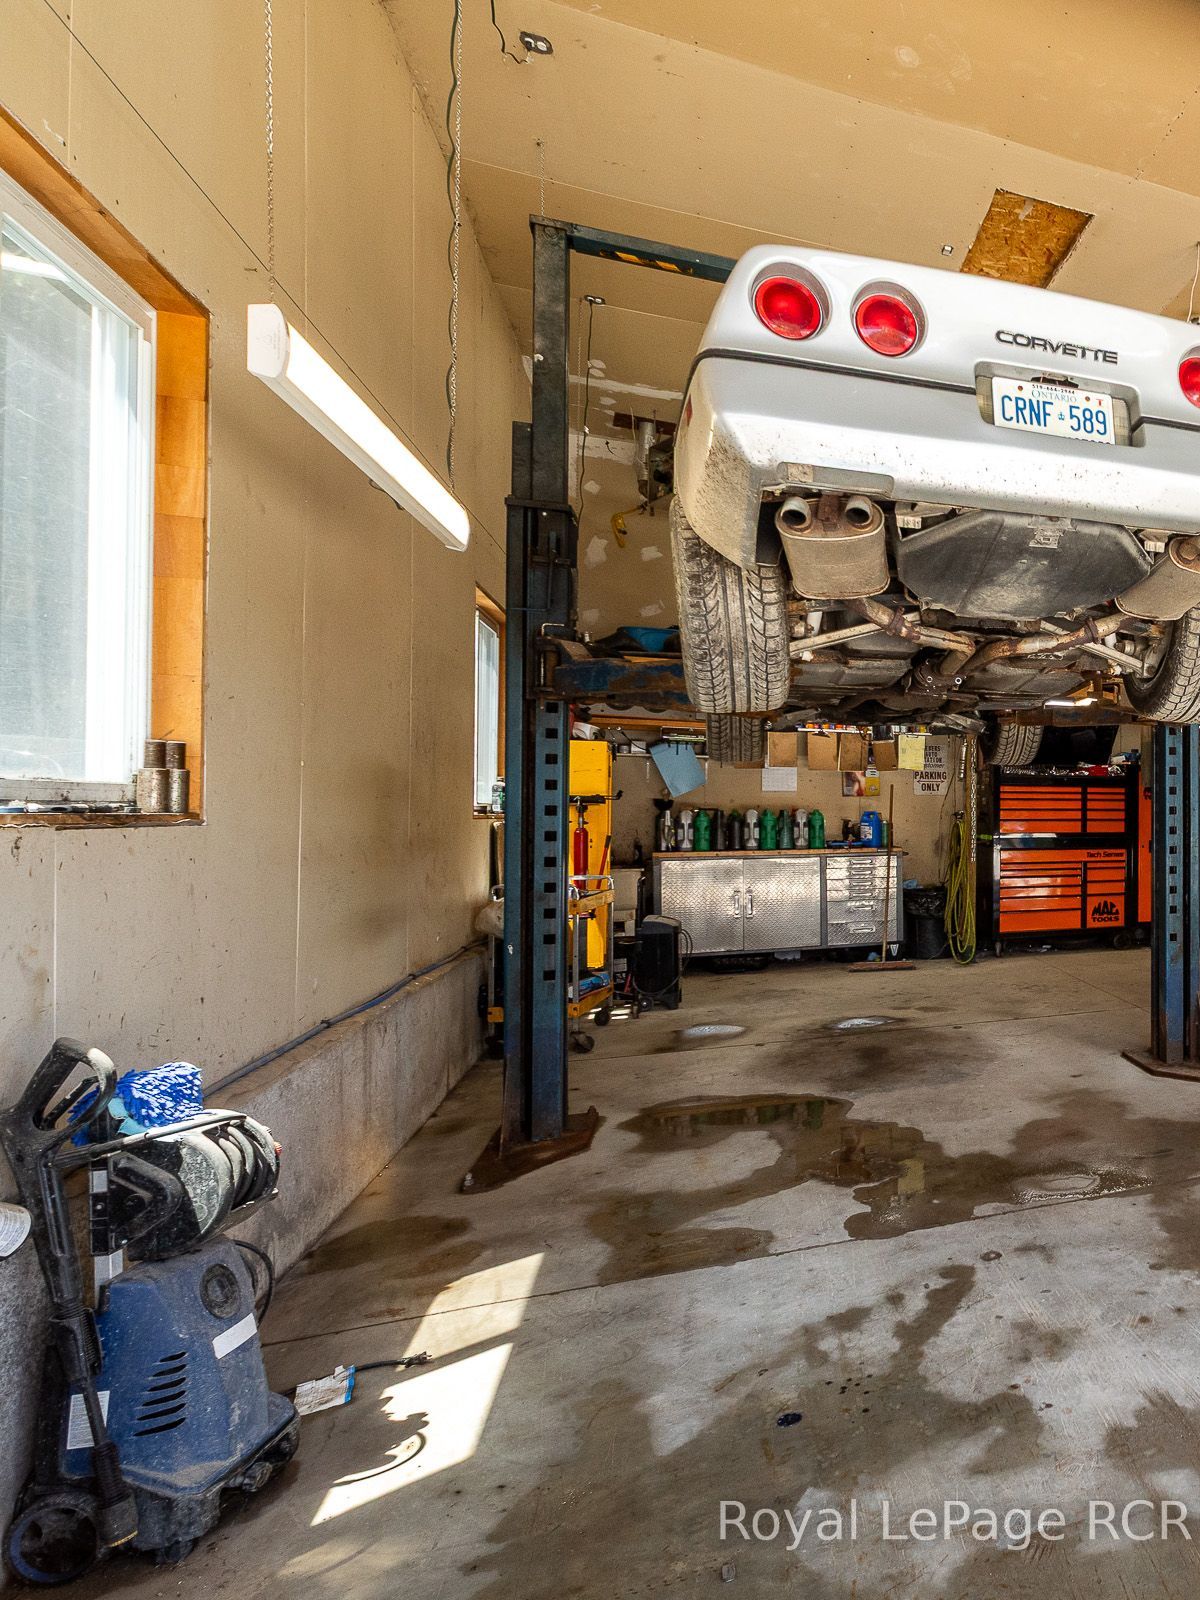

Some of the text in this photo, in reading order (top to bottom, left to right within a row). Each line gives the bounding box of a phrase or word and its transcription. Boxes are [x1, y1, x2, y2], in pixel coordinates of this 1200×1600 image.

[995, 330, 1118, 364] CORVETTE
[1001, 395, 1107, 435] CRNF 589
[914, 771, 947, 780] PARKING
[921, 783, 941, 792] ONLY
